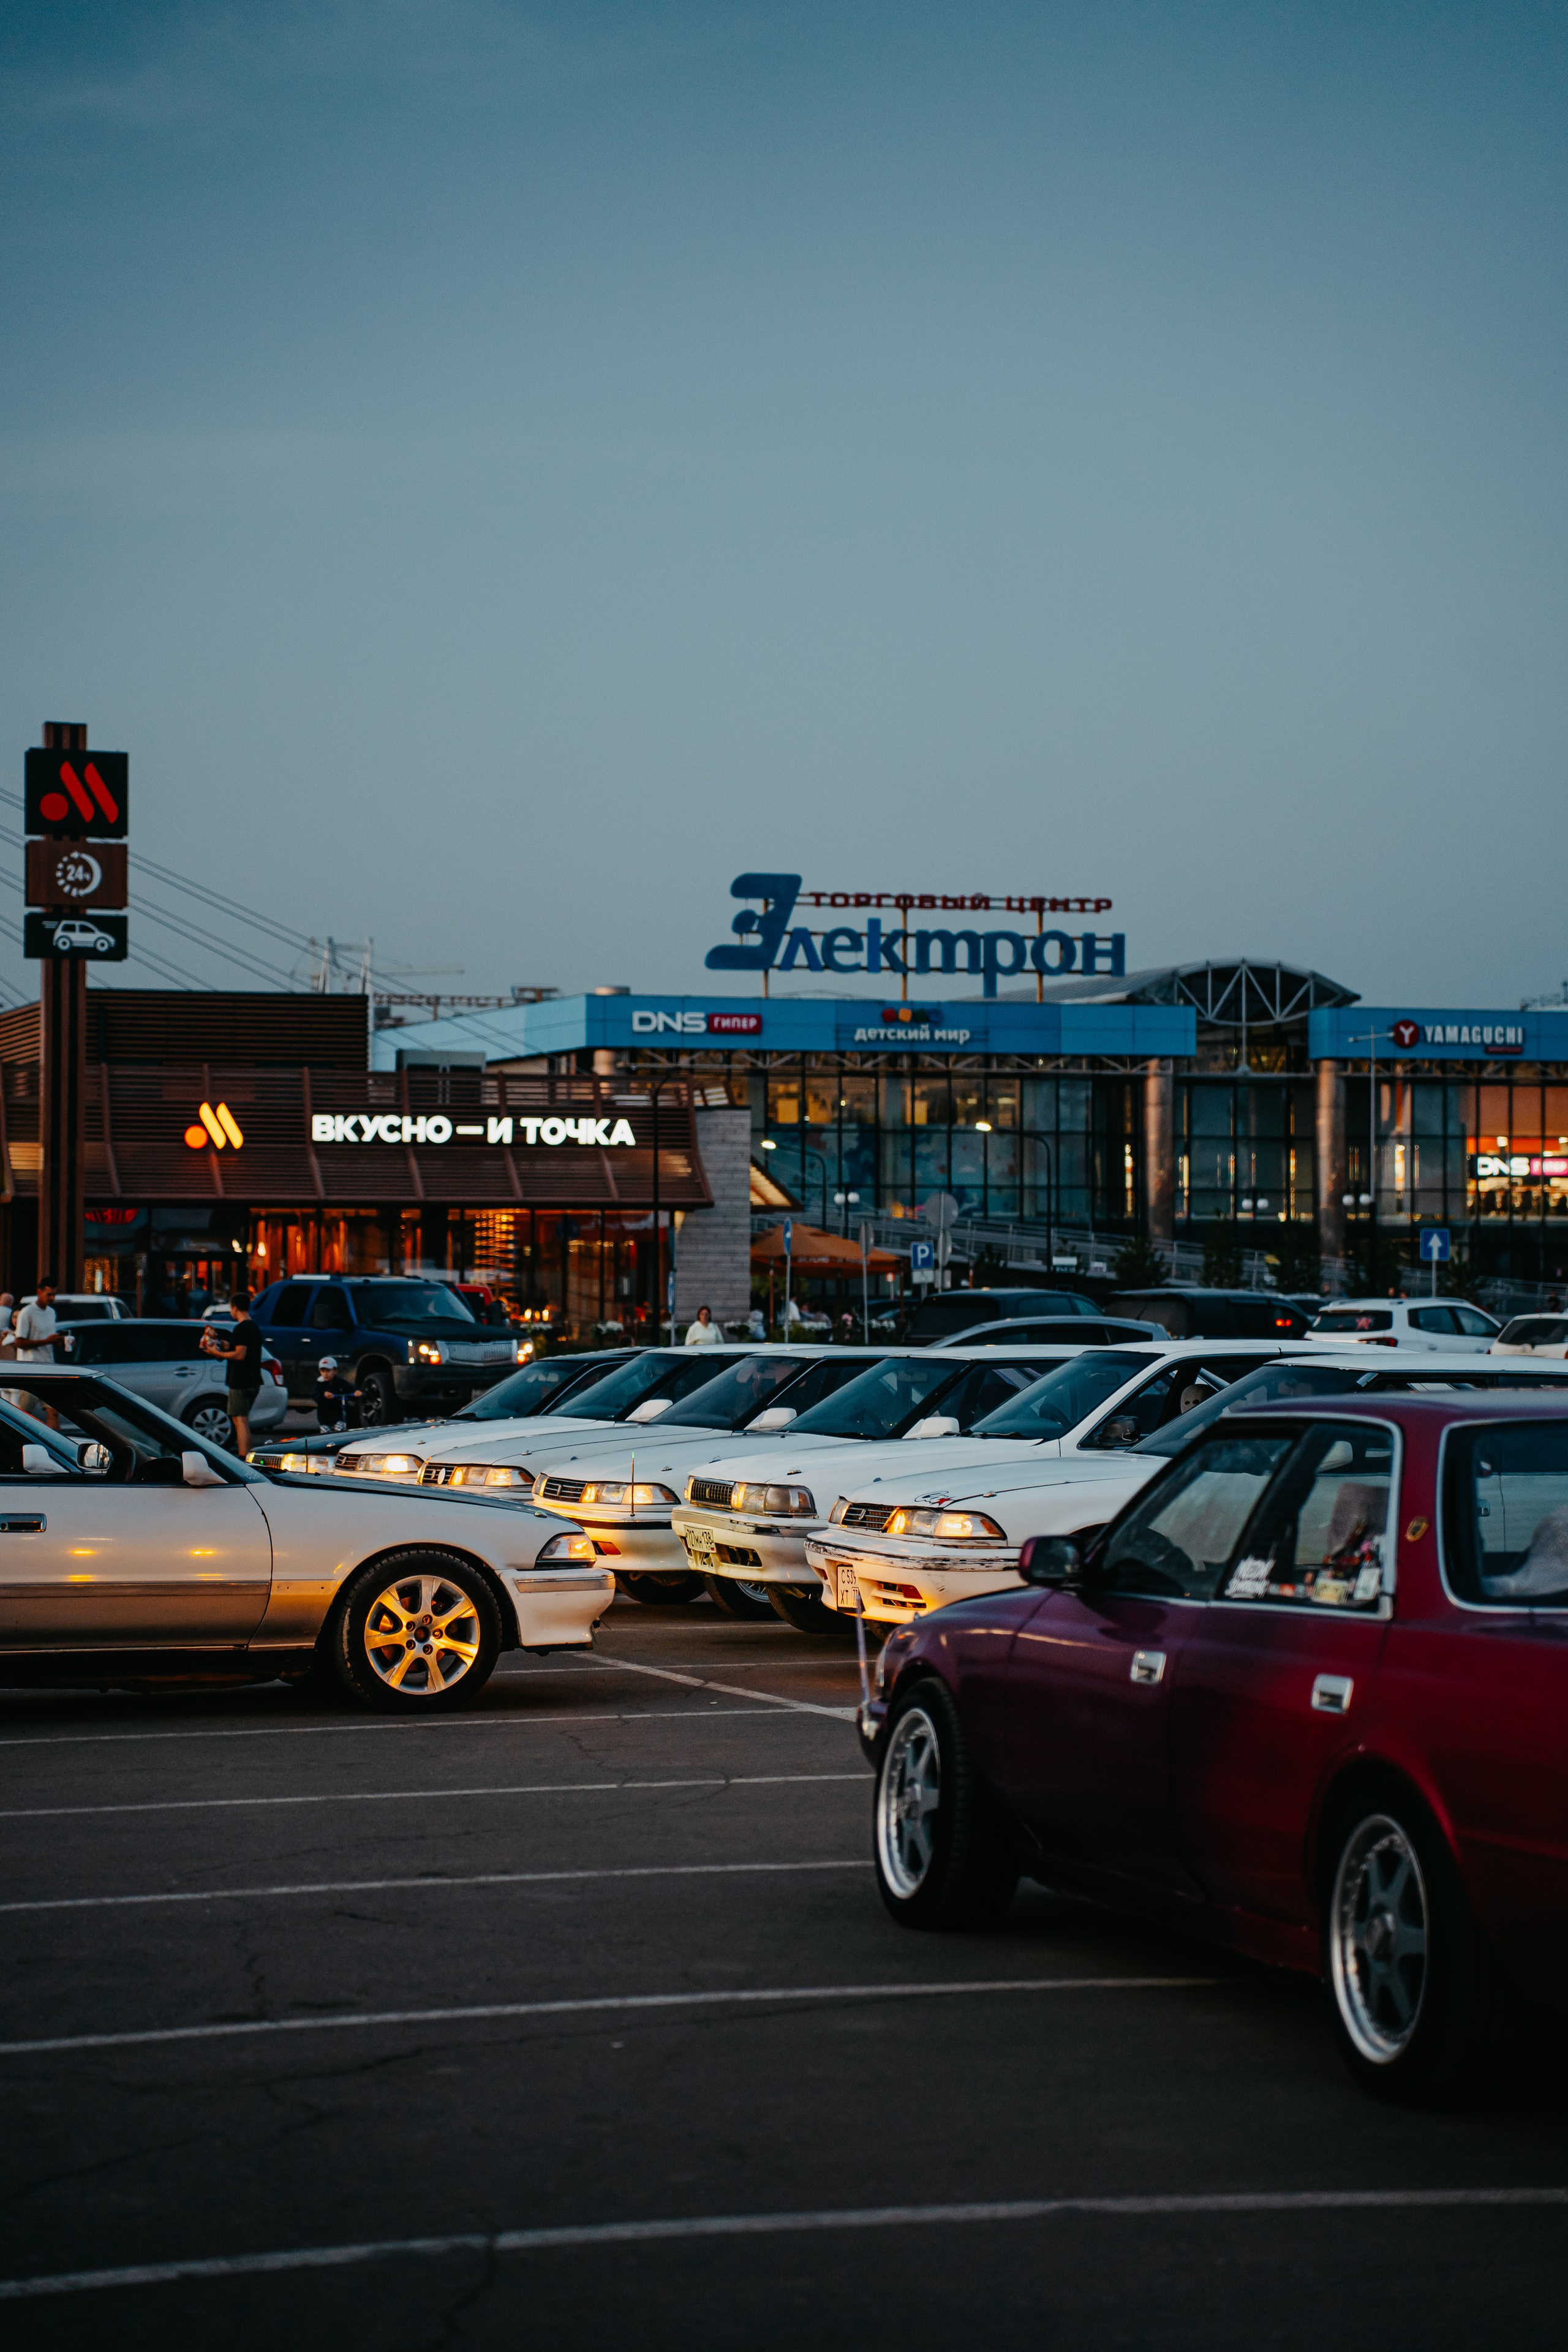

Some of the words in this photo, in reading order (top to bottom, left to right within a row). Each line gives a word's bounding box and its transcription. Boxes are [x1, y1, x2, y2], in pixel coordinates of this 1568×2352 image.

[809, 892, 990, 911] ТОРГОВЫЙ
[1006, 895, 1112, 913] ЦЕНТР
[632, 1011, 706, 1032] DNS
[714, 1017, 757, 1029] ГИПЕР
[854, 1024, 930, 1041] детский
[935, 1028, 970, 1044] мир
[1425, 1025, 1523, 1044] YAMAGUCHI
[312, 1114, 453, 1144] ВКУСНО
[519, 1117, 636, 1146] ТОЧКА
[1477, 1156, 1530, 1176] DNS
[918, 1245, 929, 1265] P
